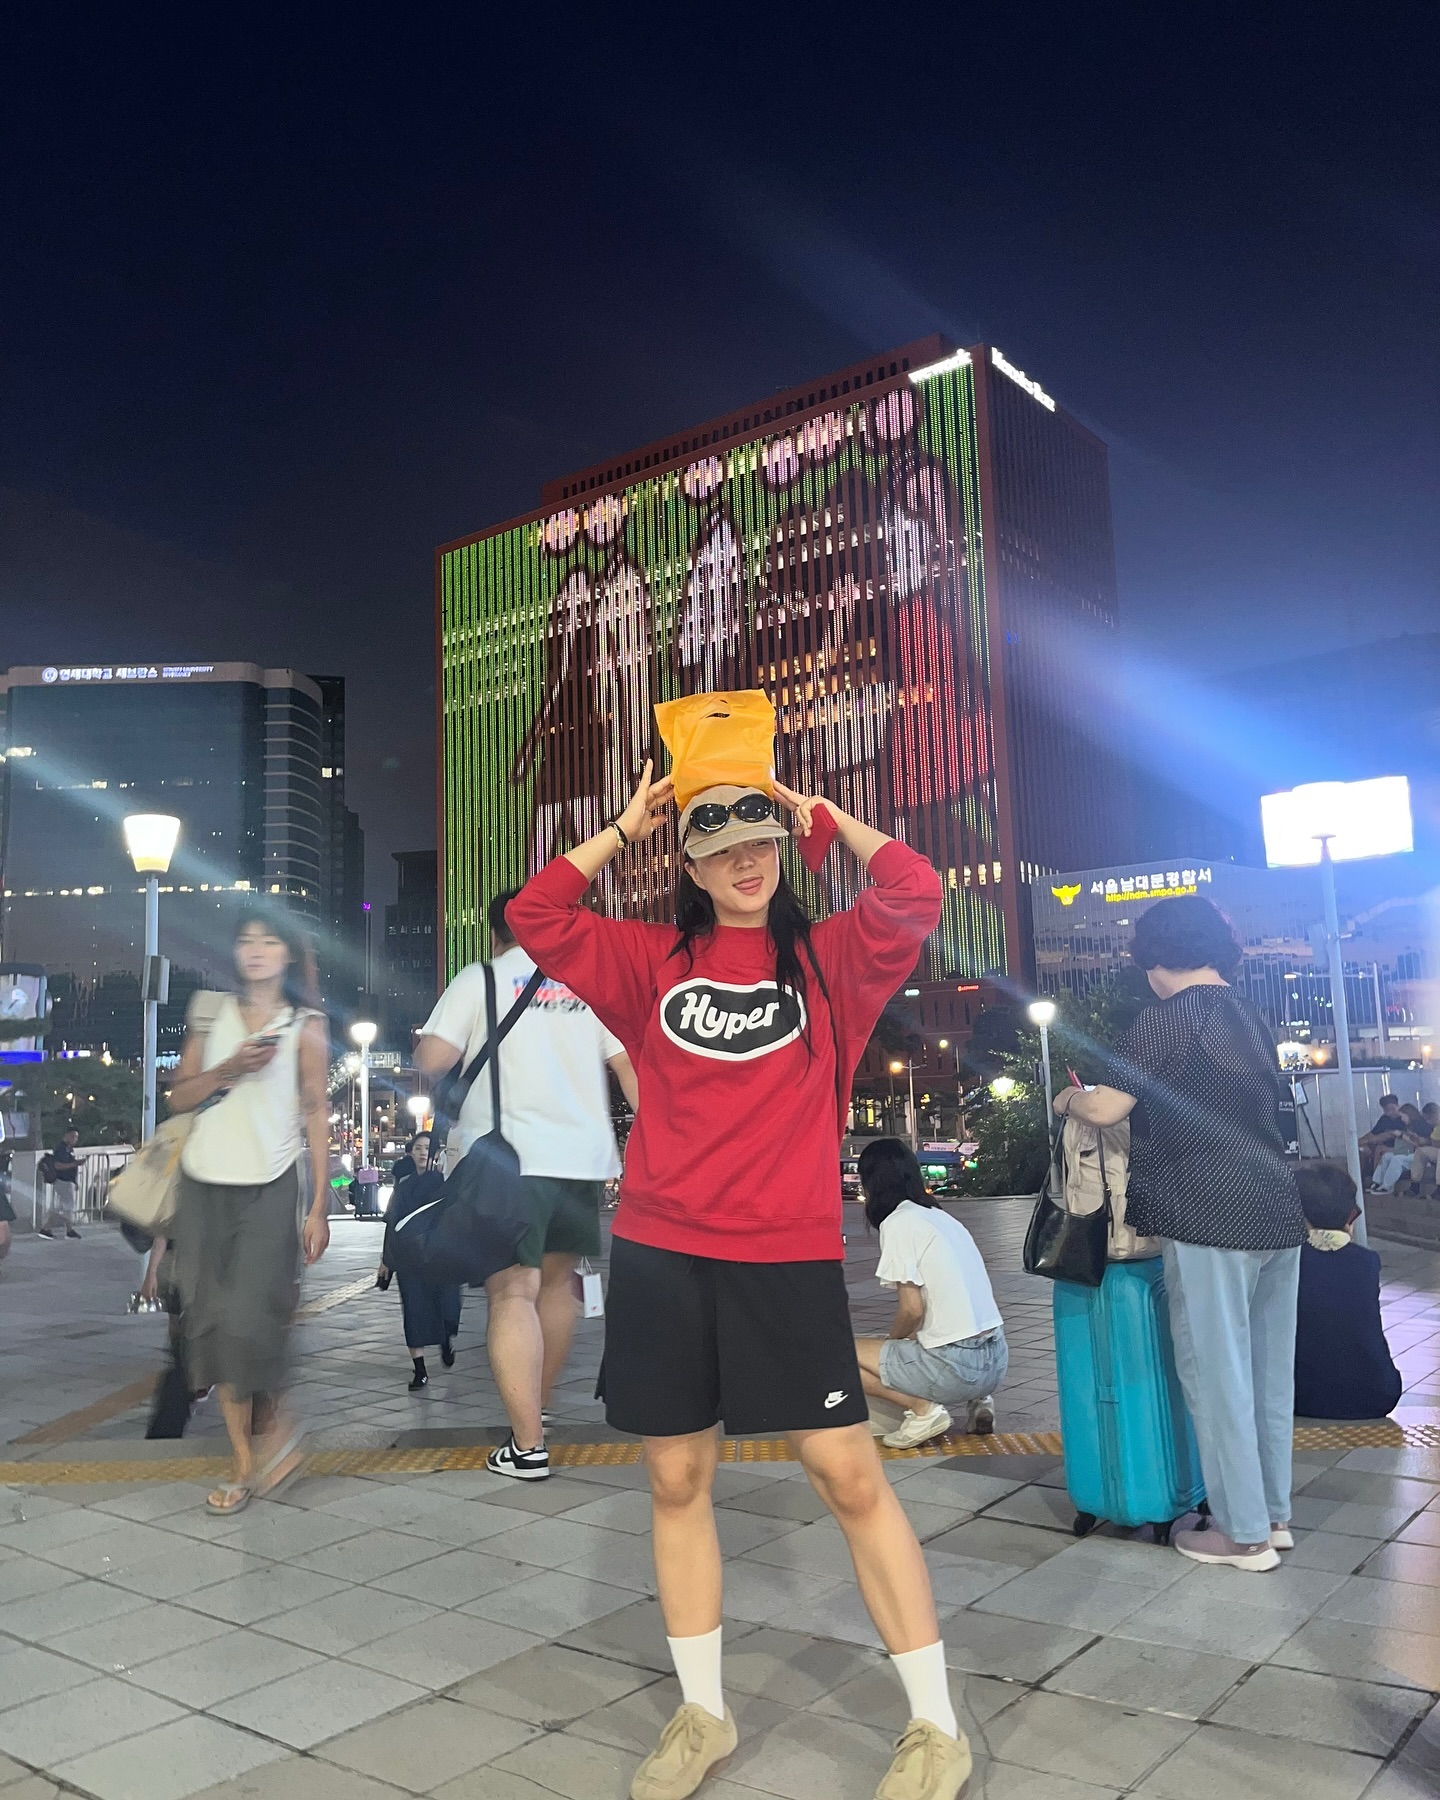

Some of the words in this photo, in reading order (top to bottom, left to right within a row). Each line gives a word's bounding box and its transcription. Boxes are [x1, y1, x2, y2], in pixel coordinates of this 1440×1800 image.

[59, 668, 113, 681] 연세대학교
[1091, 868, 1212, 895] 서울남대문경찰서
[680, 992, 780, 1040] Hyper
